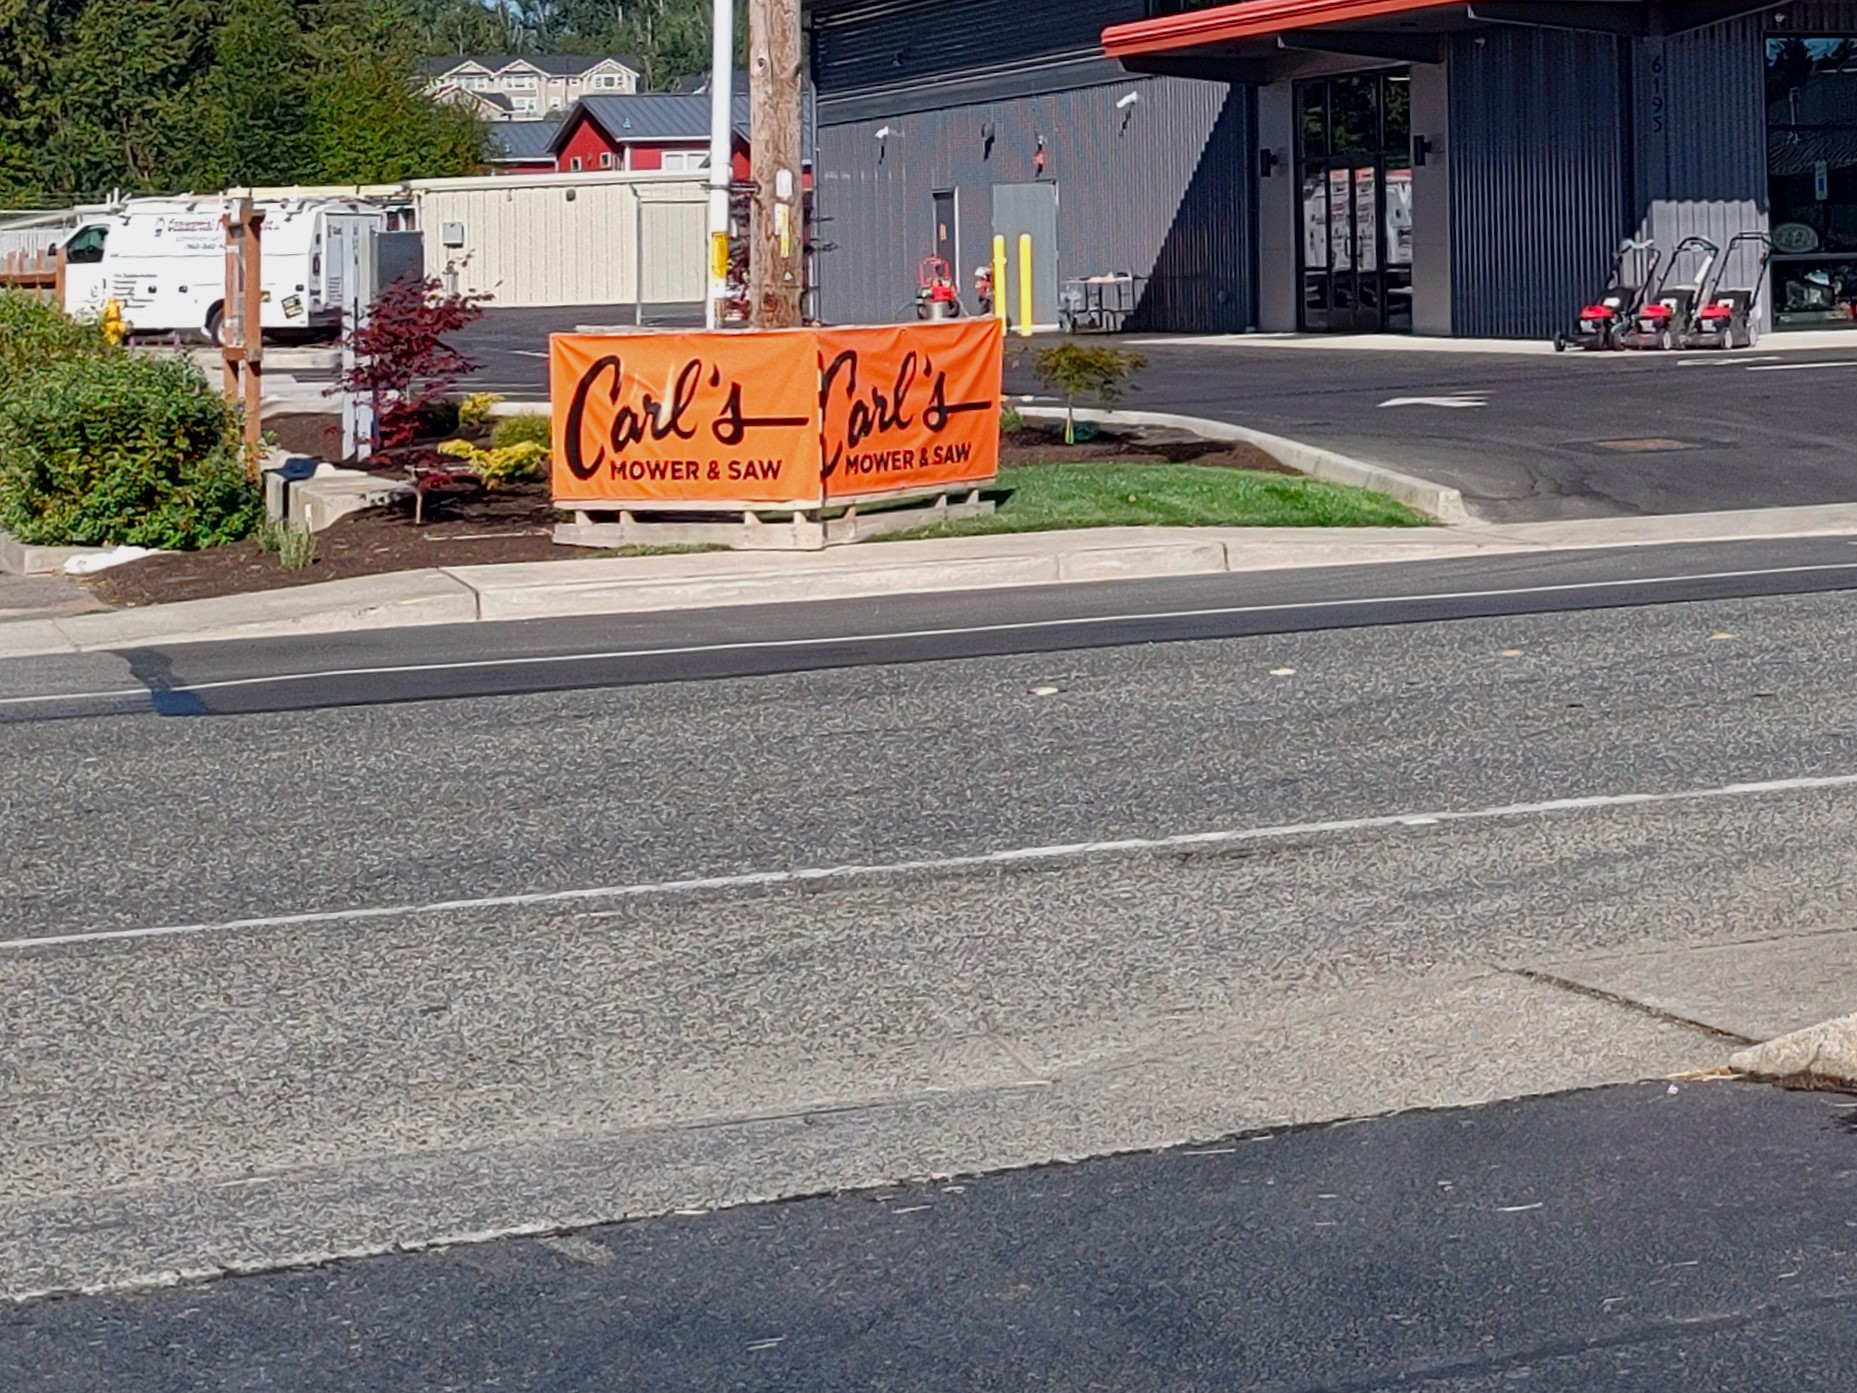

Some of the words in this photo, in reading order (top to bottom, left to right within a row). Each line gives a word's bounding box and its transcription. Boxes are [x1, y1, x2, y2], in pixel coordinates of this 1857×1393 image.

[1651, 55, 1663, 133] 6195
[564, 354, 810, 481] Carl's
[817, 349, 992, 484] Carl's
[609, 459, 700, 481] MOWER
[706, 460, 720, 481] &
[727, 459, 783, 481] SAW
[844, 447, 915, 476] MOWER
[918, 446, 930, 468] &
[932, 441, 972, 466] SAW
